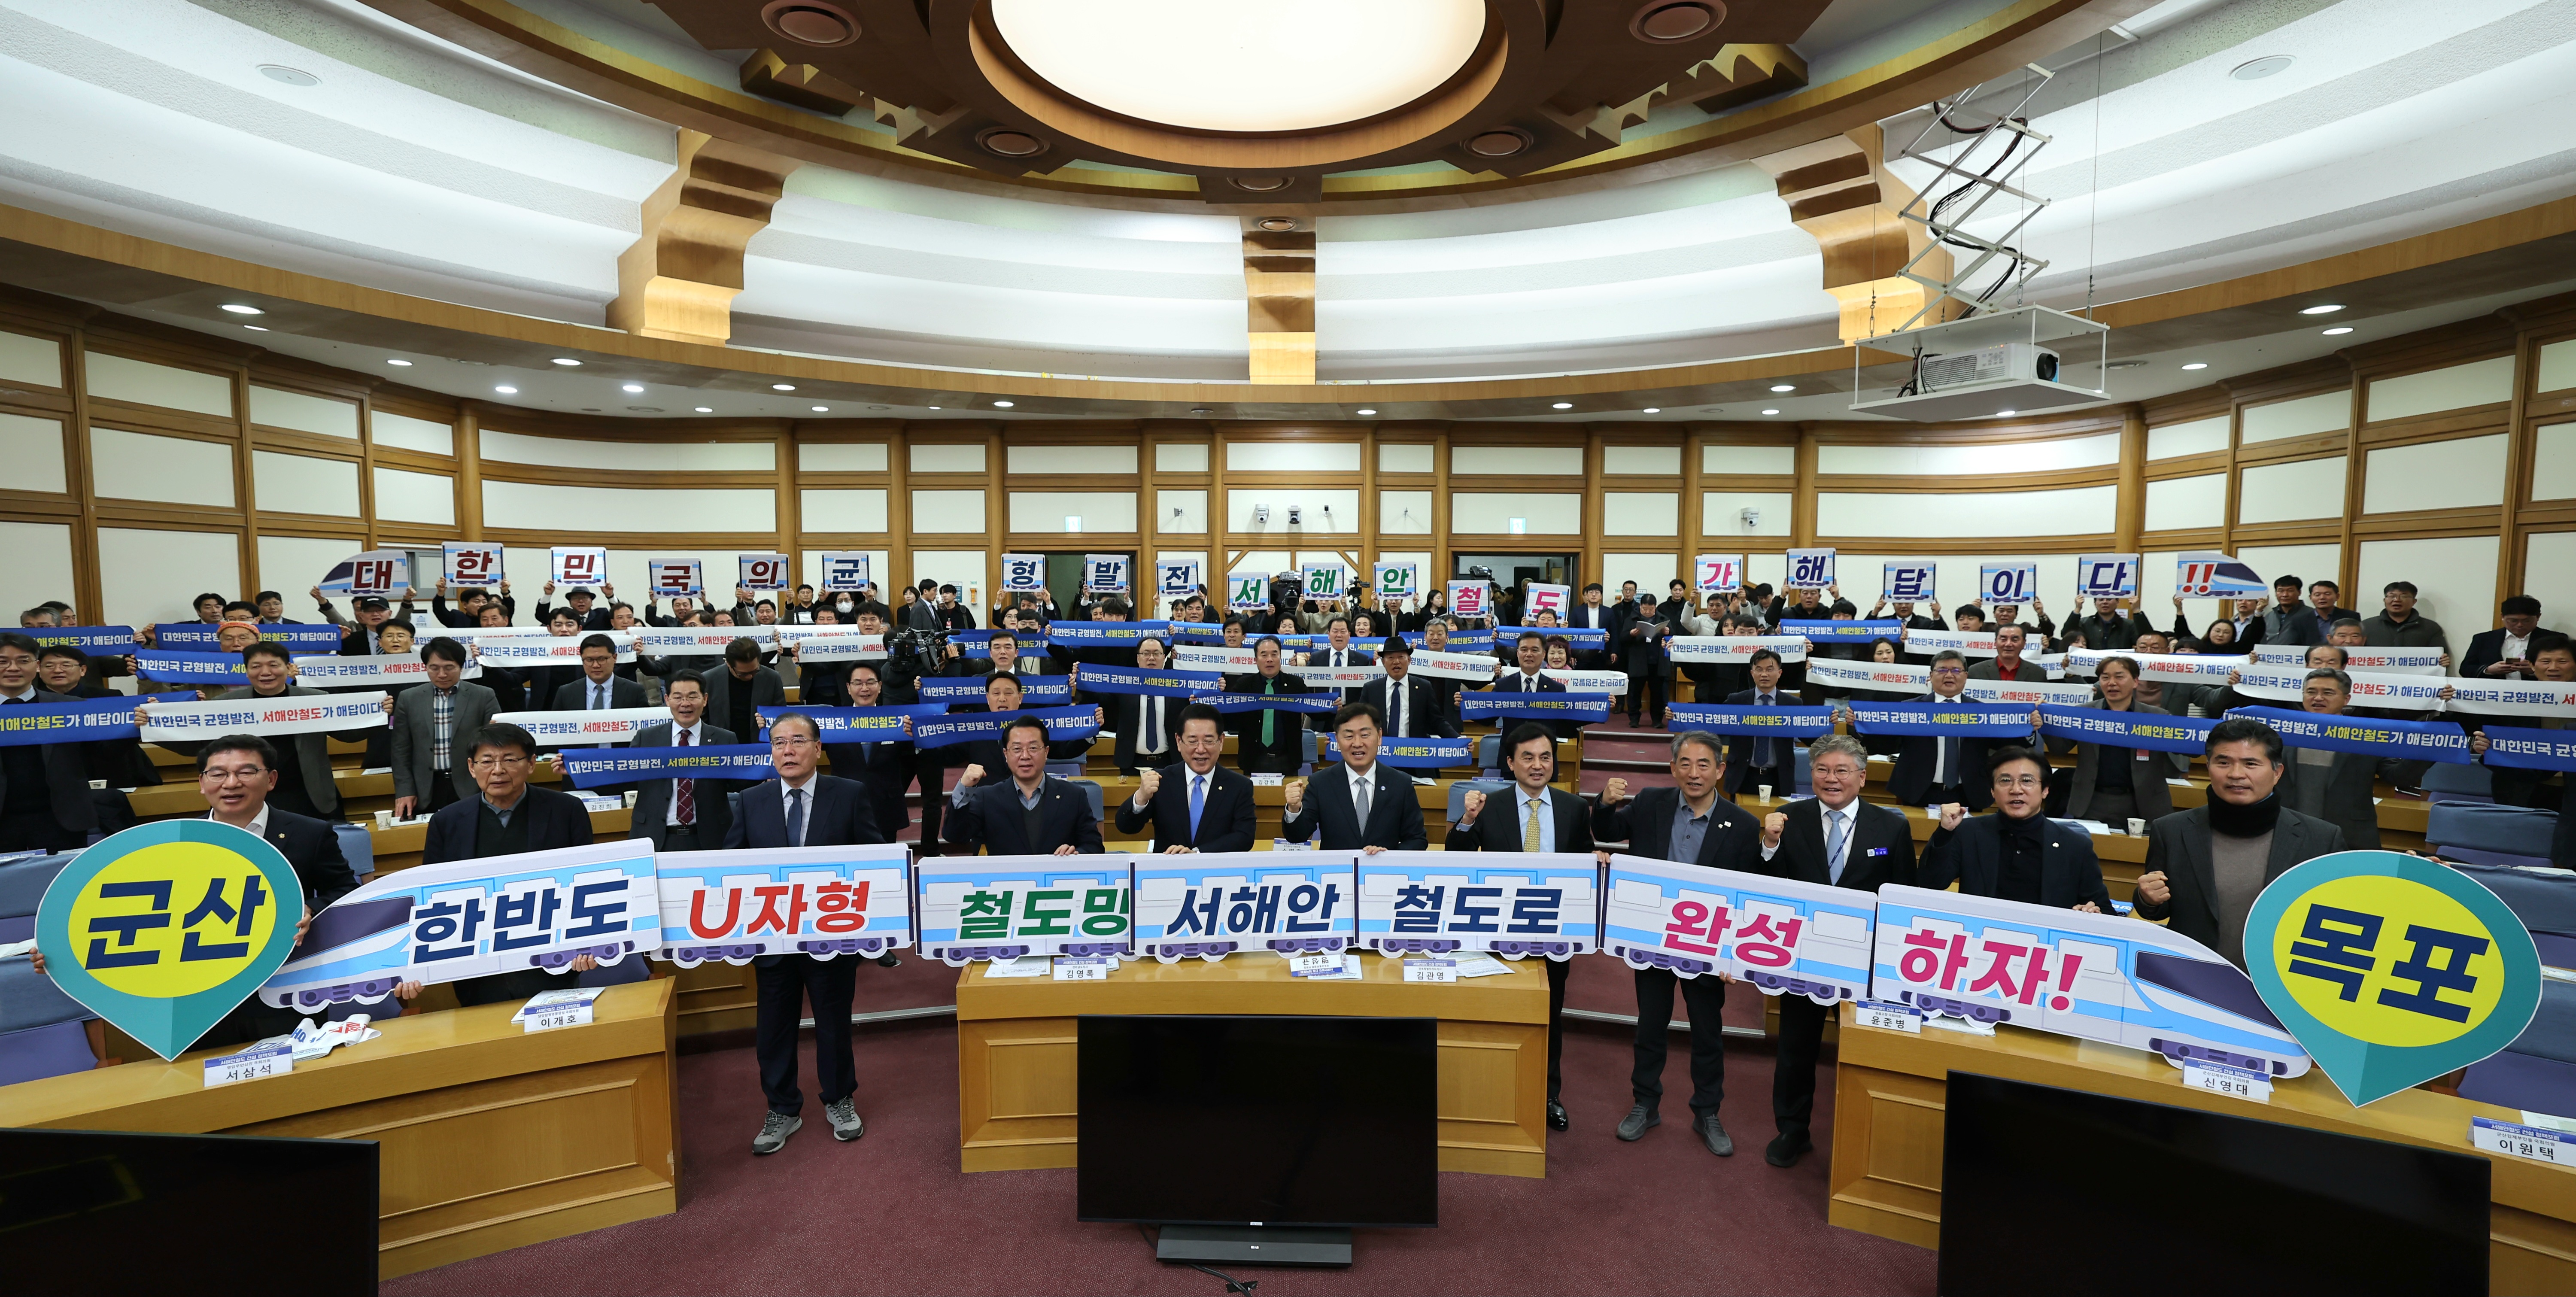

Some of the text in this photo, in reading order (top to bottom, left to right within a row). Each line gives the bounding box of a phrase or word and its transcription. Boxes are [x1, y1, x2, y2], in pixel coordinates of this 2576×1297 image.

[456, 550, 493, 580] 한
[563, 554, 595, 580] 민
[748, 560, 778, 585] 의
[832, 559, 860, 585] 균
[1011, 560, 1036, 586] 형
[1094, 561, 1121, 586] 발
[1704, 562, 1732, 586] 가
[1795, 556, 1827, 583] 해
[354, 560, 393, 589] 대
[661, 565, 692, 591] 국
[1165, 565, 1191, 591] 전
[1311, 569, 1336, 595] 해
[1383, 568, 1409, 593] 안
[1893, 568, 1926, 597] 답
[1992, 569, 2025, 598] 이
[2088, 562, 2128, 591] 다
[2182, 564, 2215, 594] !!
[1235, 578, 1262, 603] 서
[1456, 586, 1482, 613] 철
[1534, 592, 1562, 615] 도
[163, 632, 200, 642] 대한민국
[300, 632, 337, 641] 해답이다!
[1052, 628, 1169, 638] 대한민국 균형발전, 서해안철도가 해답이다!
[1187, 627, 1218, 635] 서해안철도가
[1783, 626, 1807, 634] 대한민국
[1808, 626, 1834, 635] 균형발전,
[1874, 626, 1901, 634] 해답이다!
[641, 636, 695, 645] 한민국 균형발전,
[802, 644, 860, 654] 대한민국 균형발전,
[1701, 645, 1729, 654] 균형발전,
[1774, 644, 1803, 653] 해답이다!
[1908, 637, 1964, 648] 대한민국 균형발전,
[513, 647, 549, 657] 균형발전,
[1176, 653, 1227, 664] 대한민국 균형발전,
[2258, 654, 2293, 663] 대한민국
[2348, 657, 2396, 666] 해안철도가
[137, 659, 180, 672] 대한민국
[183, 662, 228, 674] 균형발전,
[339, 665, 381, 676] 균형발전,
[1432, 660, 1468, 671] 서해안철도가
[1811, 666, 1838, 676] 대한민국
[1840, 669, 1870, 680] 균형발전,
[1872, 672, 1917, 683] 서해안철도가
[2148, 662, 2203, 674] 서해안철도가
[1081, 672, 1218, 690] 대한민국 균형발전, 서해안철도가 해답이다!
[1600, 678, 1625, 686] 대한민국
[2240, 674, 2278, 686] 대한민국
[923, 686, 954, 696] 대한민국
[1037, 685, 1068, 694] 해답이다!
[1964, 689, 2089, 703] 균형발전, 서해안철도가 해답이다!
[2503, 691, 2558, 705] 균형발전,
[1464, 700, 1606, 711] 대한민국 균형발전, 서해안철도가 해답이다!
[149, 702, 384, 728] 대한민국 균형발전, 서해안철도가 해답이다!
[1673, 713, 1829, 726] 대한민국 균형발전, 서해안철도가 해답이다!
[1854, 711, 2030, 724] 대한민국 균형발전, 서해안철도가 해답이다!
[540, 723, 580, 734] 균형발전,
[583, 721, 638, 732] 서해안철도가
[917, 723, 955, 738] 대한민국
[957, 722, 997, 732] 균형발전,
[1056, 716, 1094, 728] 해답이다!
[2044, 714, 2196, 741] 대한민국 균형발전, 서해안철도가
[2269, 719, 2467, 748] 균형발전, 서해안철도가 해답이다!
[1393, 747, 1468, 757] 서해안철도가 해답이다!
[2493, 739, 2551, 755] 대한민국
[569, 756, 730, 774] 대한민국 균형발전, 서해안철도가
[689, 881, 870, 940] U자형
[1166, 884, 1340, 936] 서해안
[1393, 884, 1562, 934] 철도로
[85, 875, 266, 970] 군산
[413, 879, 629, 965] 한반도
[1664, 900, 1802, 968] 완성
[1900, 928, 2084, 1012] 하자!
[2288, 903, 2490, 1024] 목포
[1067, 969, 1094, 978] 김영록
[541, 1015, 576, 1027] 이개호
[1871, 1016, 1904, 1029] 윤준병
[226, 1064, 271, 1080] 서삼석
[2204, 1078, 2247, 1095] 신영대
[2500, 1140, 2554, 1160] 이원택
